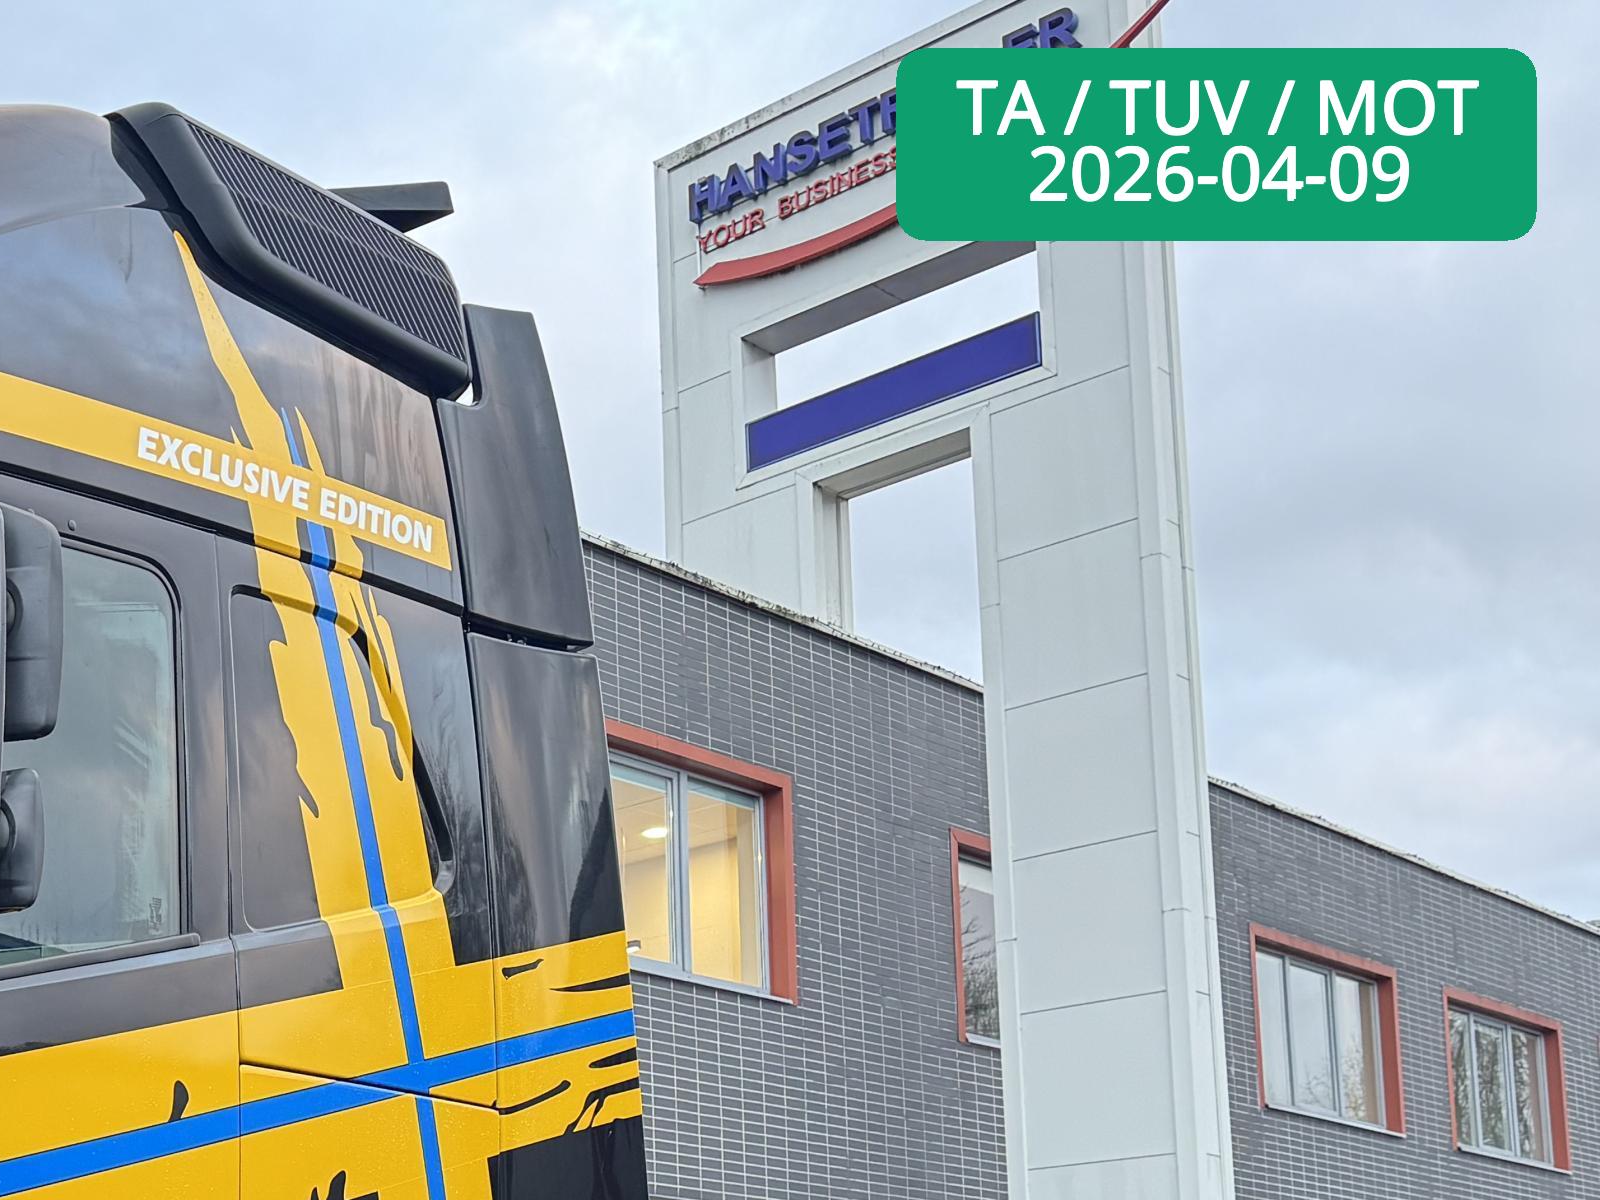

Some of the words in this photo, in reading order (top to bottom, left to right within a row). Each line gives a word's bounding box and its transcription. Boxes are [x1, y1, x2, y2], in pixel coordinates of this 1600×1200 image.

[696, 208, 765, 254] YOUR
[137, 426, 311, 511] EXCLUSIVE
[319, 486, 433, 553] EDITION
